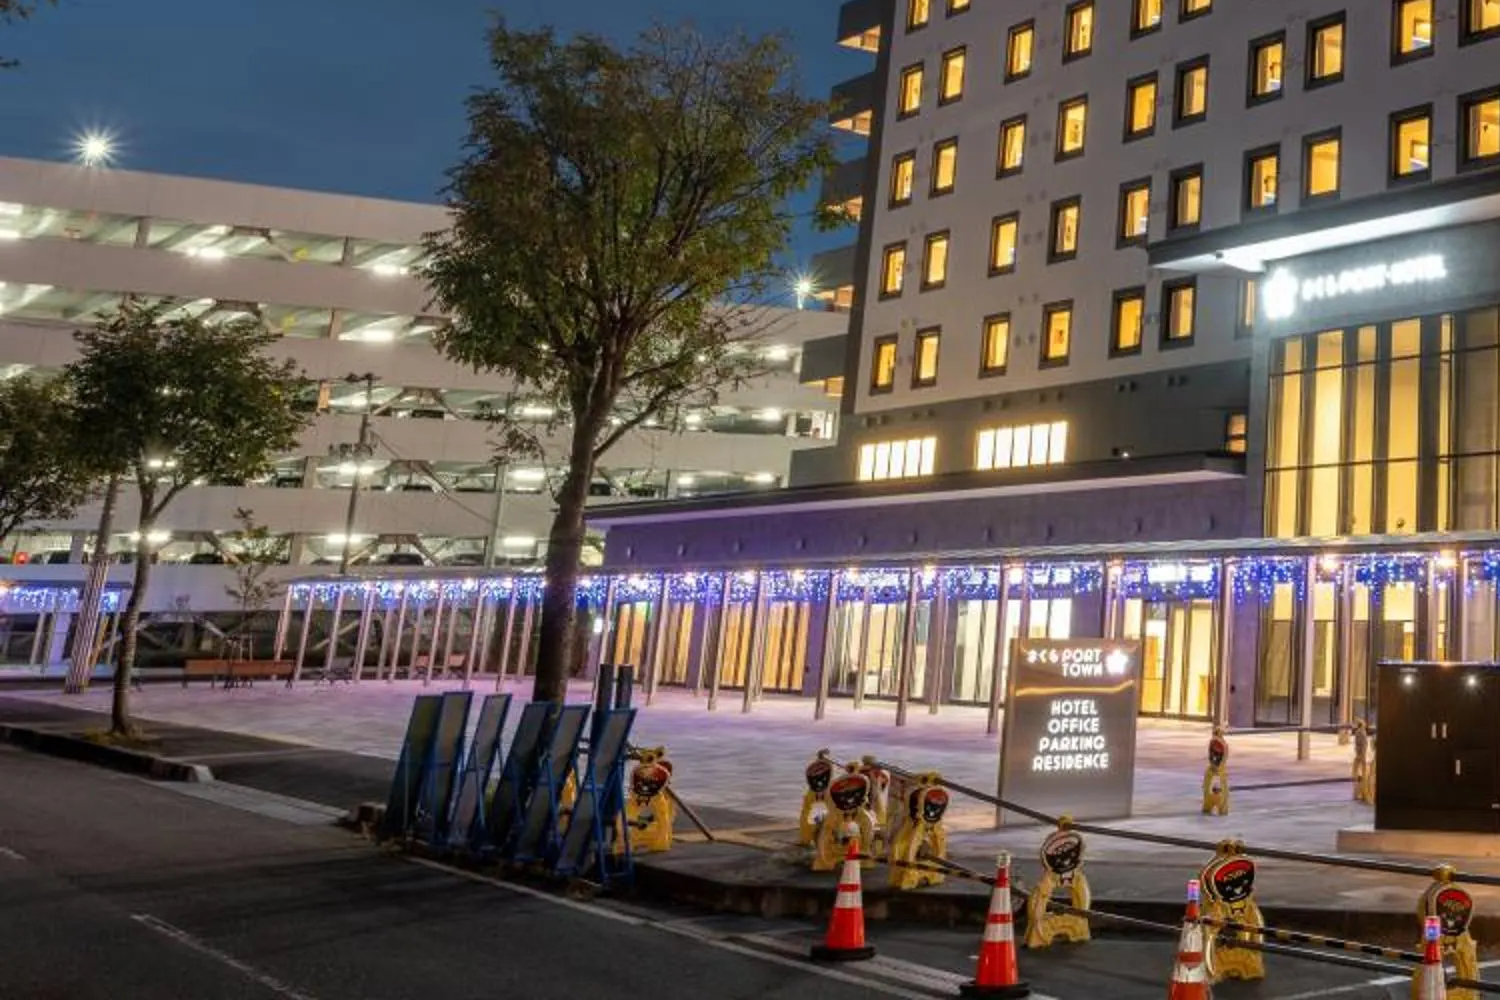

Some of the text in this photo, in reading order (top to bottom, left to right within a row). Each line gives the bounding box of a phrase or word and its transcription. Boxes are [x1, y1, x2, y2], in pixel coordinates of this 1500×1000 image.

[1062, 649, 1102, 663] PORT
[1062, 663, 1103, 677] TOWN
[1050, 700, 1098, 715] HOTEL
[1047, 718, 1100, 733] OFFICE
[1039, 736, 1105, 752] PARKING
[1032, 754, 1109, 771] RESIDENCE
